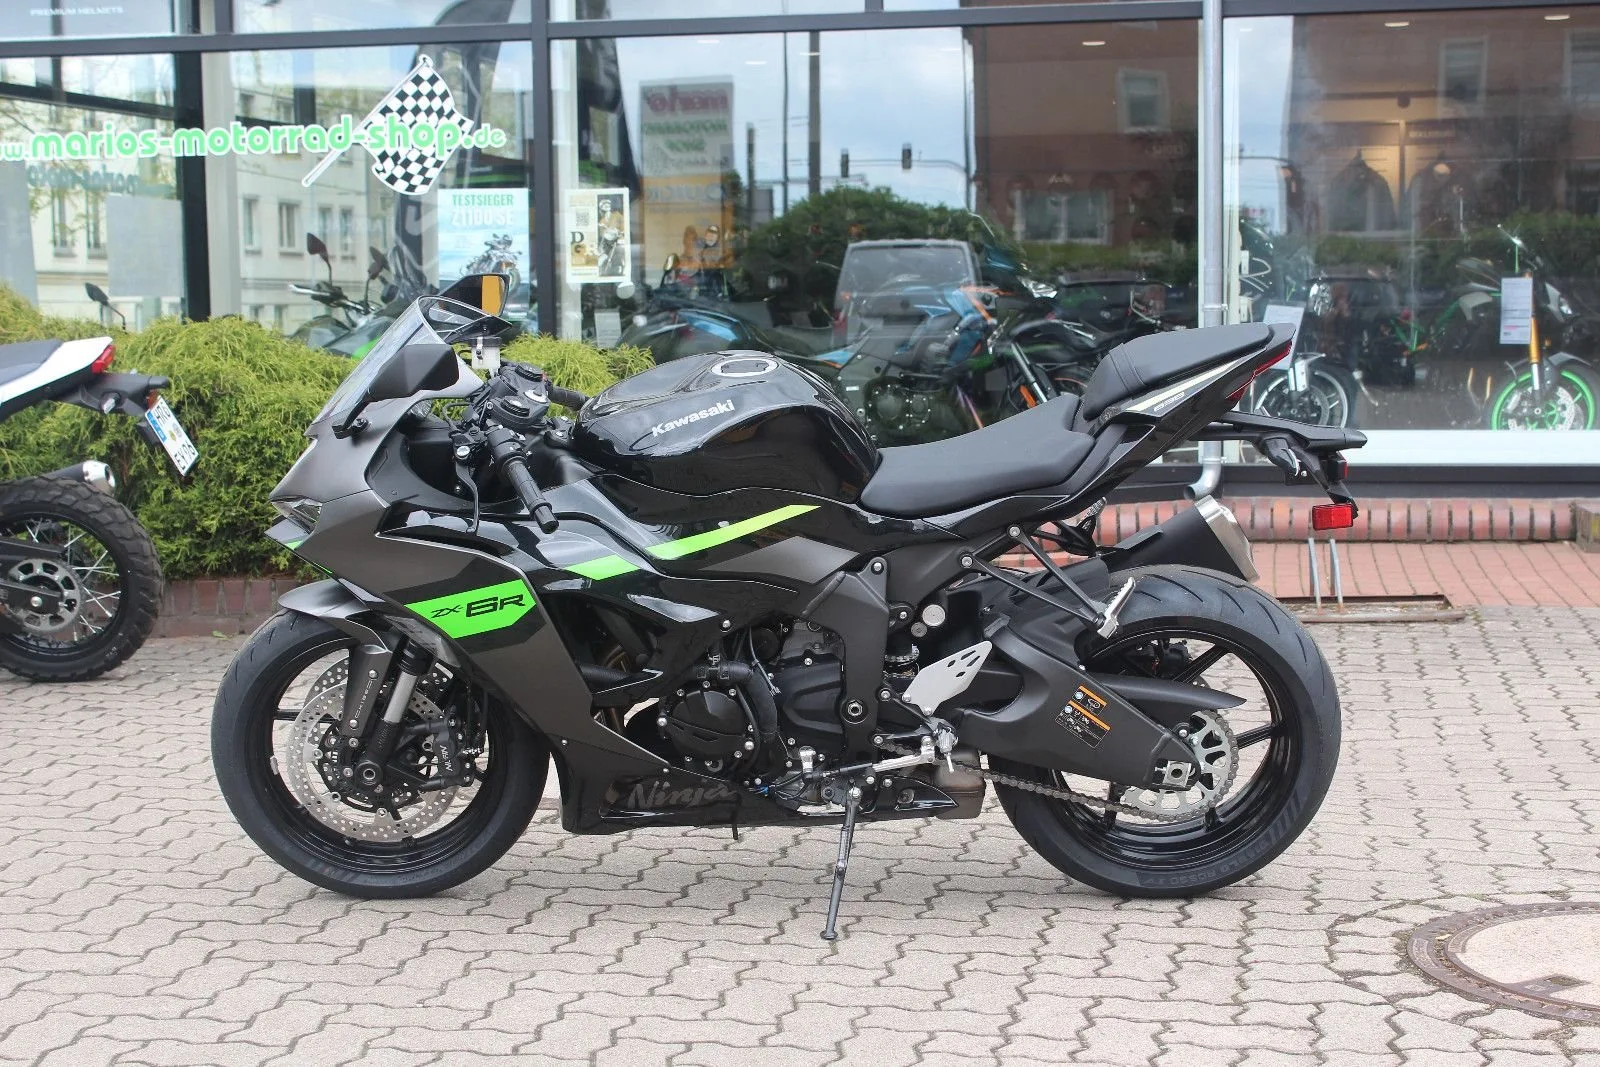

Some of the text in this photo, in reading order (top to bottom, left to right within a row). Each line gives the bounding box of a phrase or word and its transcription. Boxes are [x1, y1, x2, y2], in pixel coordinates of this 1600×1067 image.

[0, 115, 506, 160] w.marios-motorrad-shop.de
[452, 194, 514, 207] TESTSIEGER
[652, 399, 735, 437] Kawasaki
[627, 780, 738, 808] Ninja
